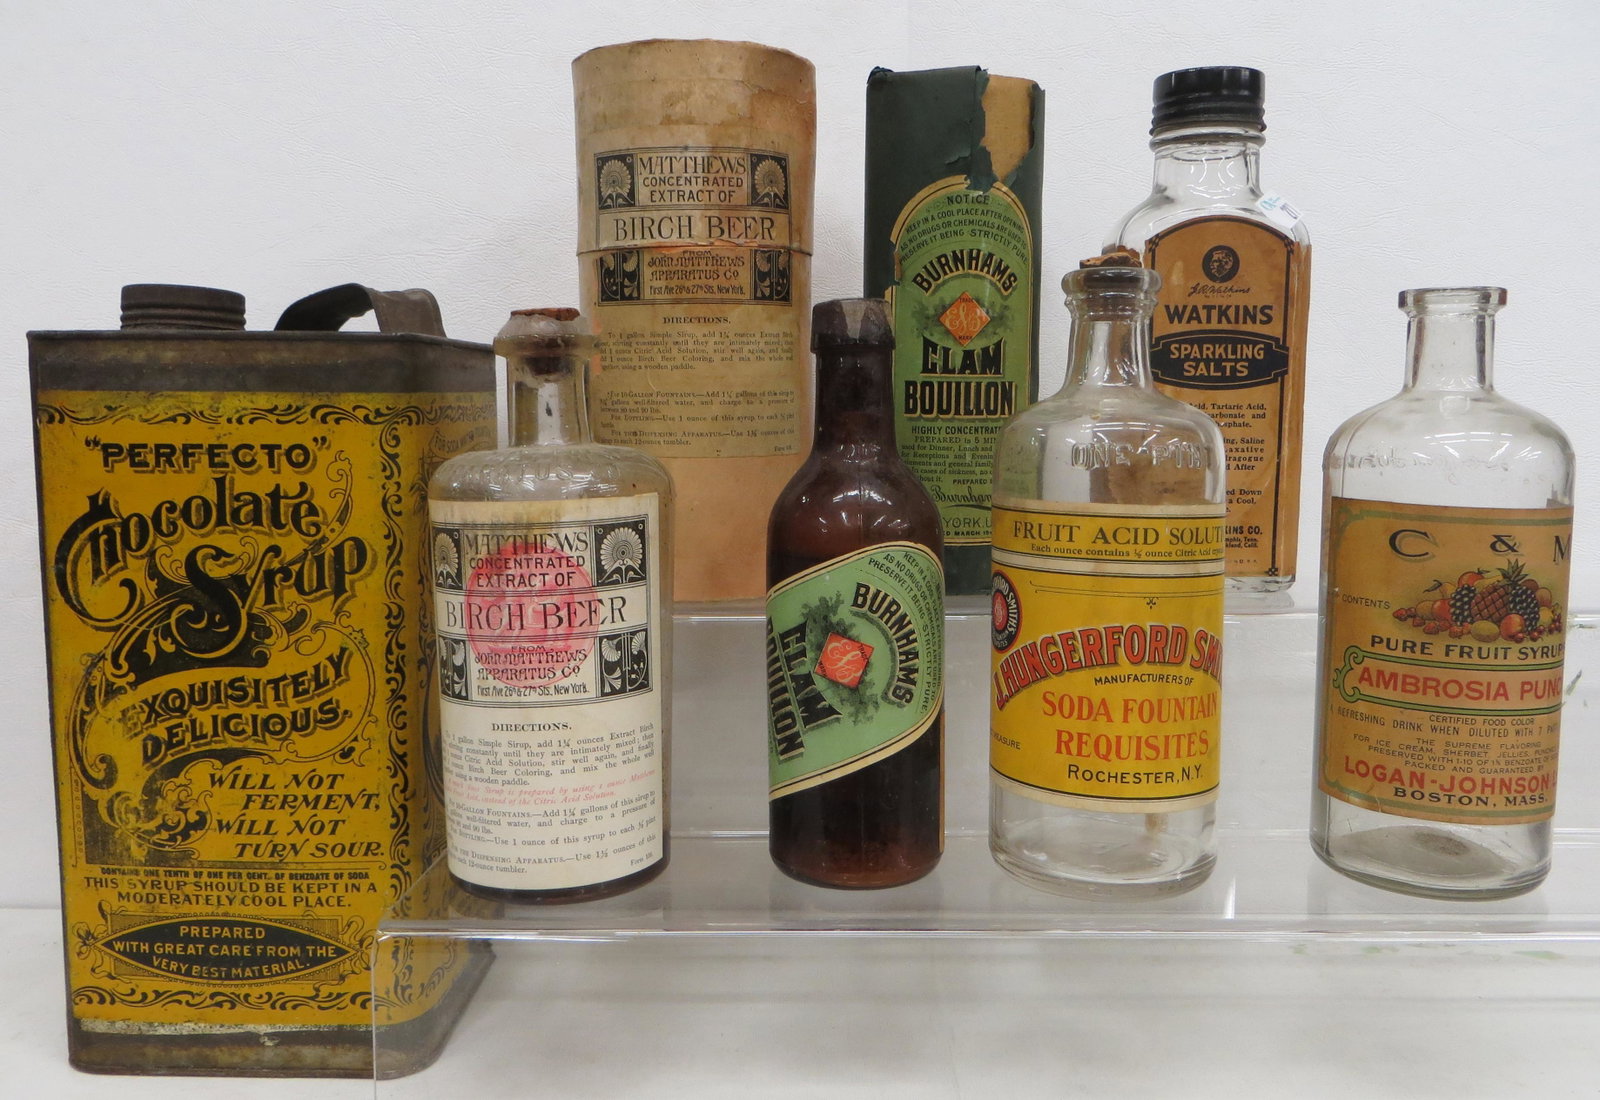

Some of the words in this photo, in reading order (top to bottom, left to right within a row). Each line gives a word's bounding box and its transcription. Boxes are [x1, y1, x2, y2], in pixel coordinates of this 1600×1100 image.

[638, 155, 746, 176] MATTHEWS
[642, 176, 744, 188] CONCENTRATED
[650, 190, 716, 203] EXTRACT
[718, 190, 736, 203] OF
[946, 194, 990, 205] NOTICE
[937, 211, 955, 219] COOL
[980, 211, 1002, 220] AFTER
[613, 215, 694, 242] BIRCH
[705, 215, 775, 241] BEER
[918, 224, 941, 237] DRUGS
[942, 221, 952, 229] OR
[953, 219, 995, 229] CHEMICALS
[939, 229, 964, 240] BEING
[969, 228, 1011, 247] STRICTLY
[912, 249, 1018, 294] BURNHAMS
[717, 285, 729, 295] New
[662, 316, 731, 325] DIRECTIONS.
[1165, 304, 1274, 324] WATKINS
[1170, 343, 1265, 359] SPARKLING
[1183, 361, 1249, 377] SALTS
[904, 380, 1015, 416] BOUILLON
[1246, 403, 1267, 411] Acid,
[912, 425, 942, 435] HIGHLY
[1240, 437, 1264, 445] Saline
[1236, 497, 1257, 505] Cool,
[1013, 521, 1081, 543] FRUIT
[1092, 526, 1159, 545] ACID
[1169, 525, 1223, 545] SOLUT
[1247, 526, 1263, 535] CO.
[54, 475, 324, 624] Chocolate
[465, 532, 589, 555] MATTHEWS
[1031, 543, 1050, 553] Each
[1054, 547, 1082, 555] ounce
[1086, 549, 1129, 557] contains
[1175, 548, 1197, 557] Citric
[1388, 528, 1432, 558] C
[1489, 534, 1520, 554] &
[469, 555, 585, 569] CONCENTRATED
[883, 553, 895, 564] AS
[895, 560, 905, 572] NO
[477, 572, 552, 588] EXTRACT
[555, 571, 576, 587] OF
[868, 557, 906, 588] PRESERVE
[170, 536, 369, 659] Syrup
[1341, 594, 1391, 610] CONTENTS
[446, 600, 525, 631] BIRCH
[540, 596, 627, 630] BEER
[851, 581, 920, 705] BURNHAMS
[1370, 634, 1434, 656] PURE
[1444, 643, 1512, 660] FRUIT
[1094, 673, 1183, 686] MANUFACTURERS
[1184, 677, 1194, 686] OF
[1358, 666, 1510, 702] AMBROSIA
[120, 646, 351, 735] EXQUISITELY
[554, 685, 569, 694] New
[1042, 691, 1114, 723] SODA
[1122, 691, 1217, 723] FOUNTAIN
[492, 722, 572, 732] DIRECTIONS.
[1338, 708, 1386, 726] REFRESHING
[1392, 719, 1423, 733] DRINK
[1430, 725, 1460, 737] WHEN
[1468, 727, 1509, 738] DILUTED
[1514, 726, 1533, 737] WITH
[1429, 714, 1477, 726] CERTIFIED
[1482, 718, 1506, 726] FOOD
[1510, 717, 1535, 726] COLOR
[142, 698, 350, 767] DELICIOUS.
[479, 739, 502, 748] Simple
[508, 741, 532, 749] Sirup,
[610, 729, 635, 741] Extract
[503, 750, 520, 758] until
[527, 750, 545, 759] they
[571, 744, 611, 755] intimately
[1055, 729, 1209, 762] REQUISITES
[1367, 745, 1424, 761] PRESERVED
[1443, 749, 1488, 758] SHERBET
[1444, 741, 1492, 750] SUPREME
[1500, 741, 1541, 750] FLAVORING
[515, 768, 553, 778] Coloring,
[1404, 760, 1446, 771] PACKED
[1451, 765, 1473, 774] AND
[1479, 766, 1534, 774] GUARANTEED
[208, 765, 276, 790] WILL
[284, 768, 345, 790] NOT
[502, 778, 530, 786] paddle.
[241, 788, 381, 817] FERMENT,
[1393, 787, 1497, 808] BOSTON,
[1504, 793, 1548, 807] MASS.
[580, 805, 608, 816] gallons
[216, 813, 279, 836] WILL
[287, 813, 346, 836] NOT
[583, 834, 605, 843] syrup
[235, 838, 310, 863] TURN
[309, 842, 385, 858] SOUR.
[143, 869, 160, 878] ONE
[163, 869, 189, 879] TENTH
[193, 870, 203, 879] OF
[207, 870, 224, 880] ONE
[227, 871, 243, 880] PER
[275, 872, 285, 881] OF
[289, 872, 330, 881] BENZOATE
[334, 872, 344, 881] OF
[347, 871, 370, 880] SODA
[496, 865, 527, 873] tumbler.
[83, 877, 118, 889] THIS
[128, 878, 187, 891] SYRUP
[193, 881, 260, 893] SHOULD
[265, 882, 285, 894] BE
[292, 883, 339, 894] KEPT
[344, 882, 362, 893] IN
[366, 882, 377, 893] A
[117, 892, 237, 908] MODERATELY
[241, 895, 287, 908] COOL
[293, 896, 352, 908] PLACE.
[180, 925, 265, 939] PREPARED
[112, 940, 149, 954] WITH
[153, 942, 205, 956] GREAT
[208, 944, 251, 957] CARE
[256, 945, 300, 957] FROM
[305, 945, 337, 958] THE
[151, 956, 189, 973] VERY
[191, 965, 228, 978] BEST
[231, 960, 311, 978] MATERIAL.
